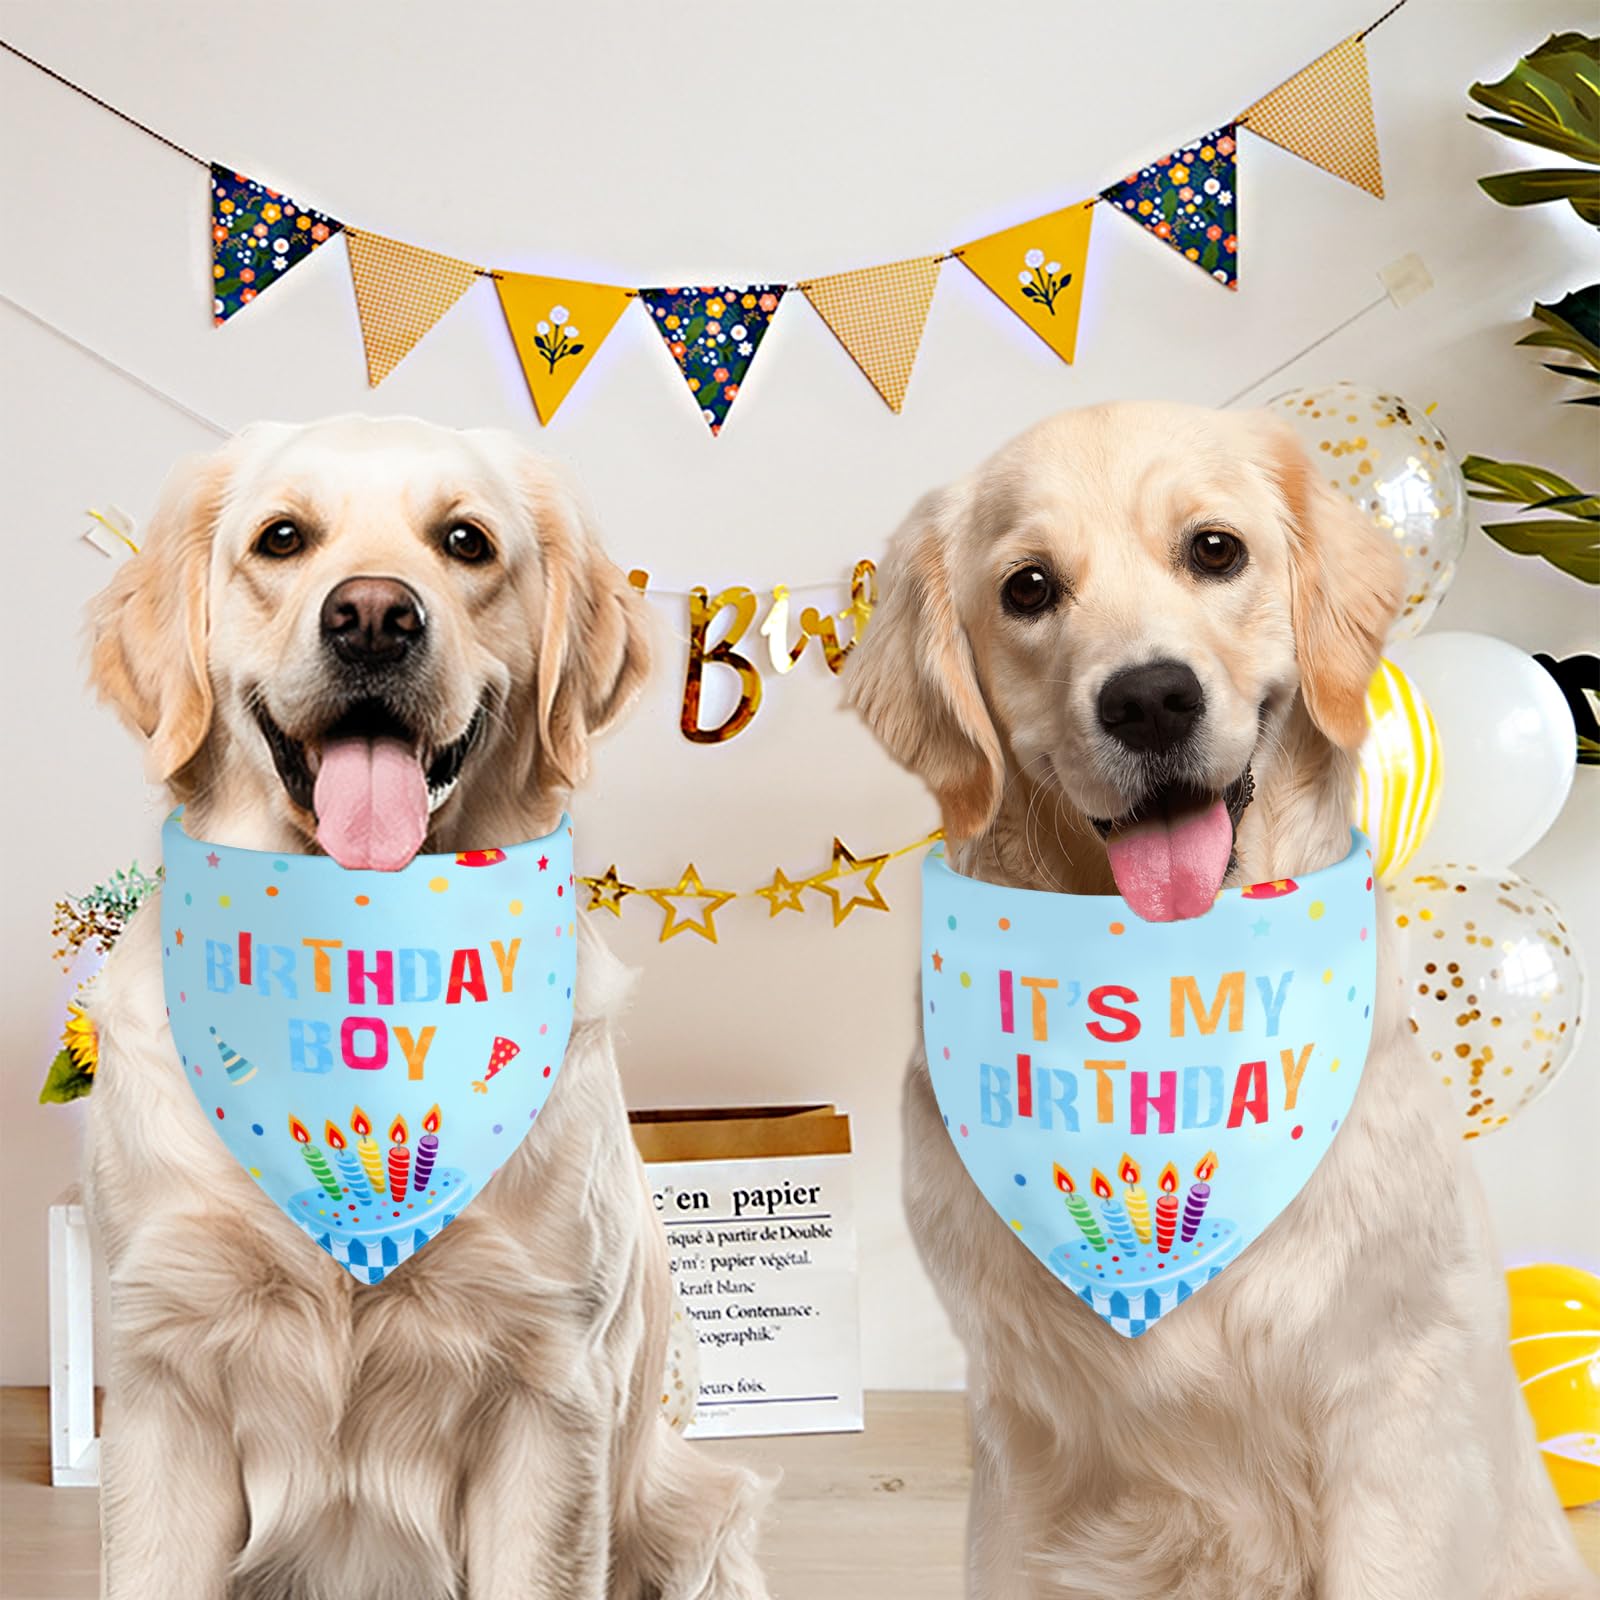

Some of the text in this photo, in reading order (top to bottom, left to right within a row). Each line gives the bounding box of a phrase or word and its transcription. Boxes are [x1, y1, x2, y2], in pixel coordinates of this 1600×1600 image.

[206, 931, 522, 1005] BIRTHDAY
[999, 969, 1295, 1043] IT'S MY
[288, 1016, 437, 1081] BOY
[979, 1042, 1315, 1135] BIRTHDAY
[733, 1181, 820, 1216] papier
[711, 1254, 755, 1272] papier
[718, 1227, 757, 1247] partir
[760, 1226, 777, 1241] de
[780, 1224, 833, 1239] Double
